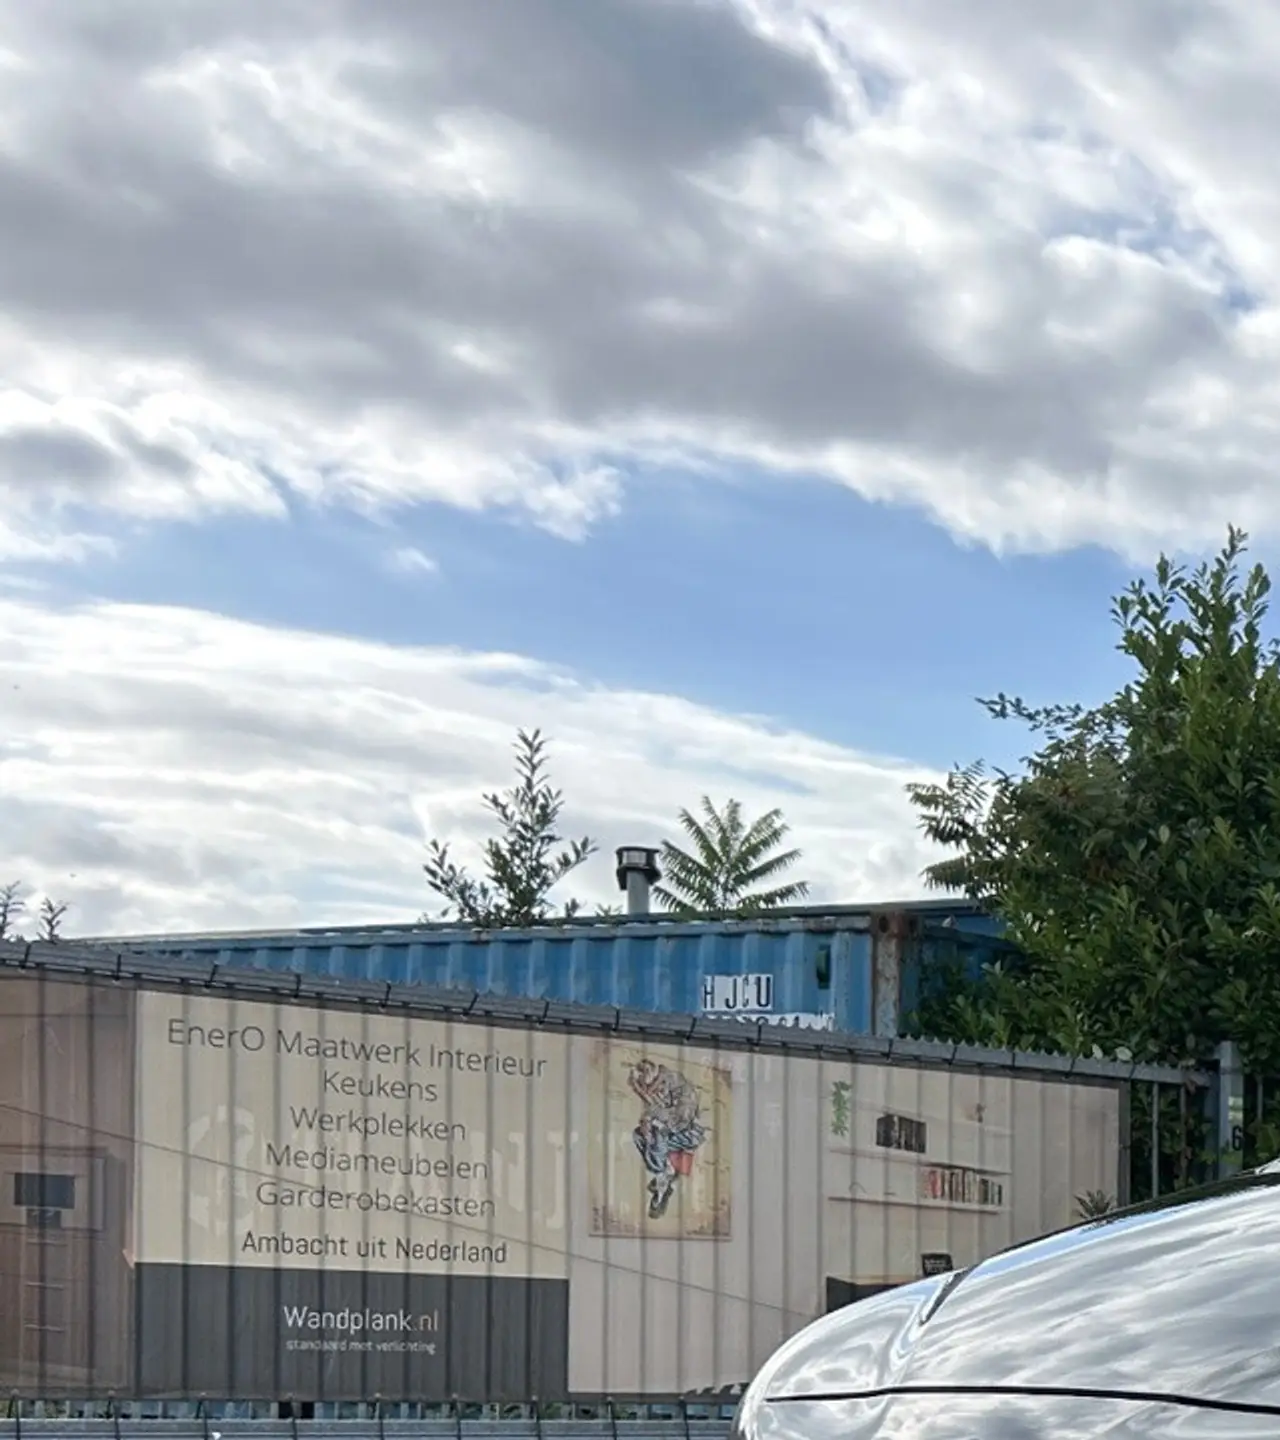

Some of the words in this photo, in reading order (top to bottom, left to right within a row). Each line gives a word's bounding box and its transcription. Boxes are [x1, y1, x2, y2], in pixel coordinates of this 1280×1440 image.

[168, 1018, 265, 1051] EnerO
[276, 1029, 422, 1068] Maatwerk
[429, 1044, 548, 1078] Interieur
[324, 1069, 438, 1102] Keukens
[289, 1105, 466, 1141] Werkplekken
[265, 1142, 489, 1180] Mediameubelen
[255, 1181, 496, 1218] Garderobekasten
[241, 1230, 349, 1257] Ambacht
[356, 1236, 387, 1259] uit
[395, 1237, 508, 1264] Nederland
[283, 1305, 440, 1335] Wandplank.nl
